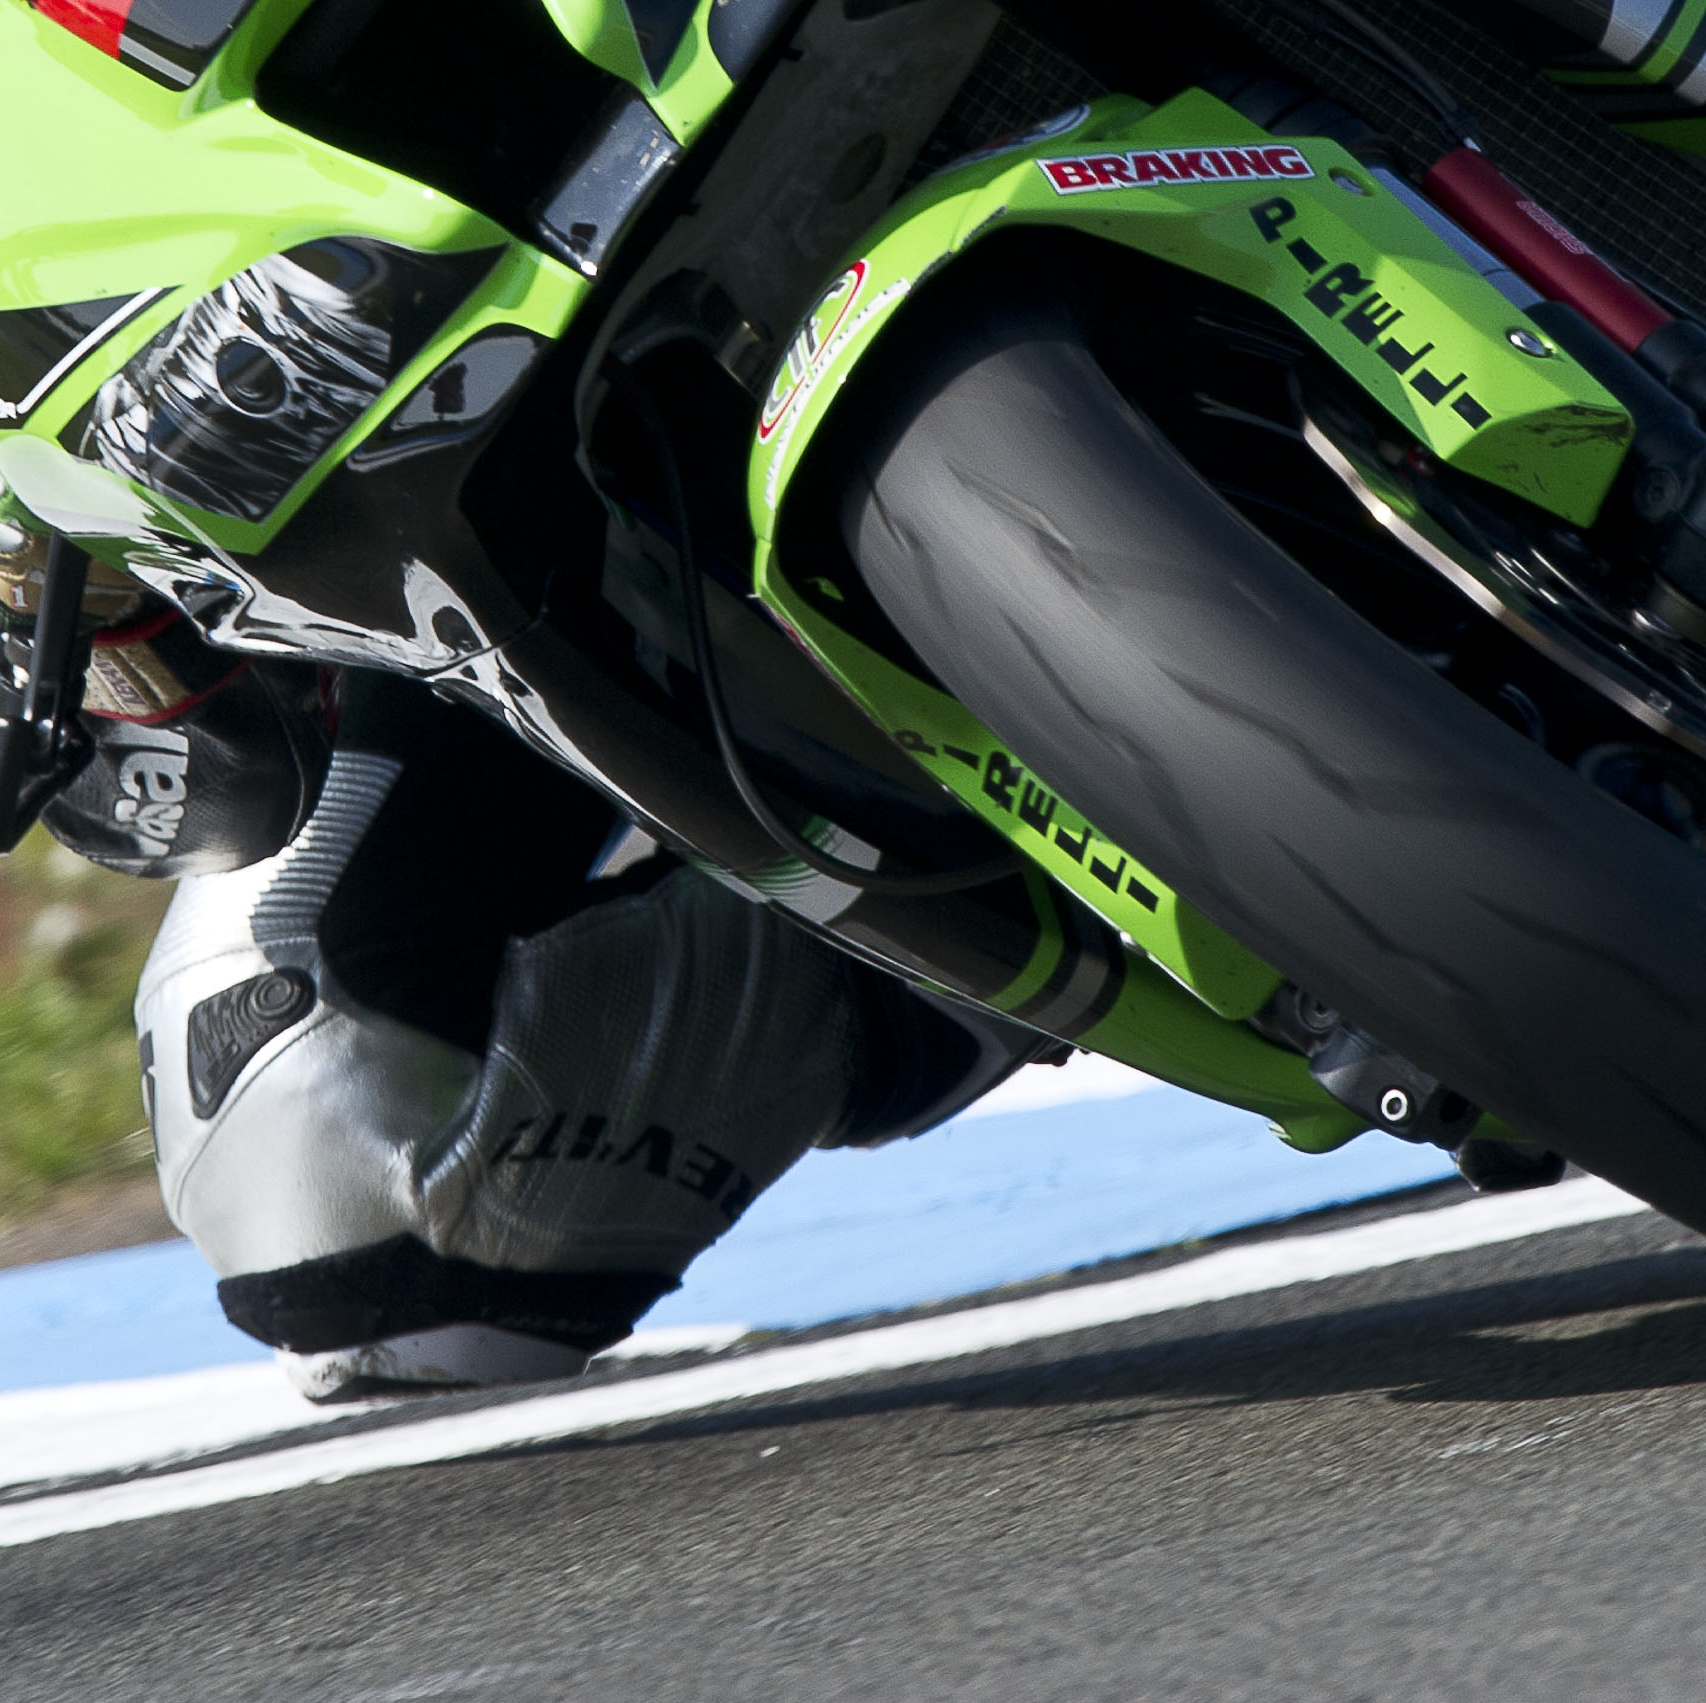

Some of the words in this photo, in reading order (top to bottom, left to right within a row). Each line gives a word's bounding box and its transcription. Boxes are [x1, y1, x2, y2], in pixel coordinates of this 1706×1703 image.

[1042, 146, 1312, 193] BRAKING
[1251, 196, 1492, 430] PIRELLI
[894, 728, 1160, 914] PIRELLI
